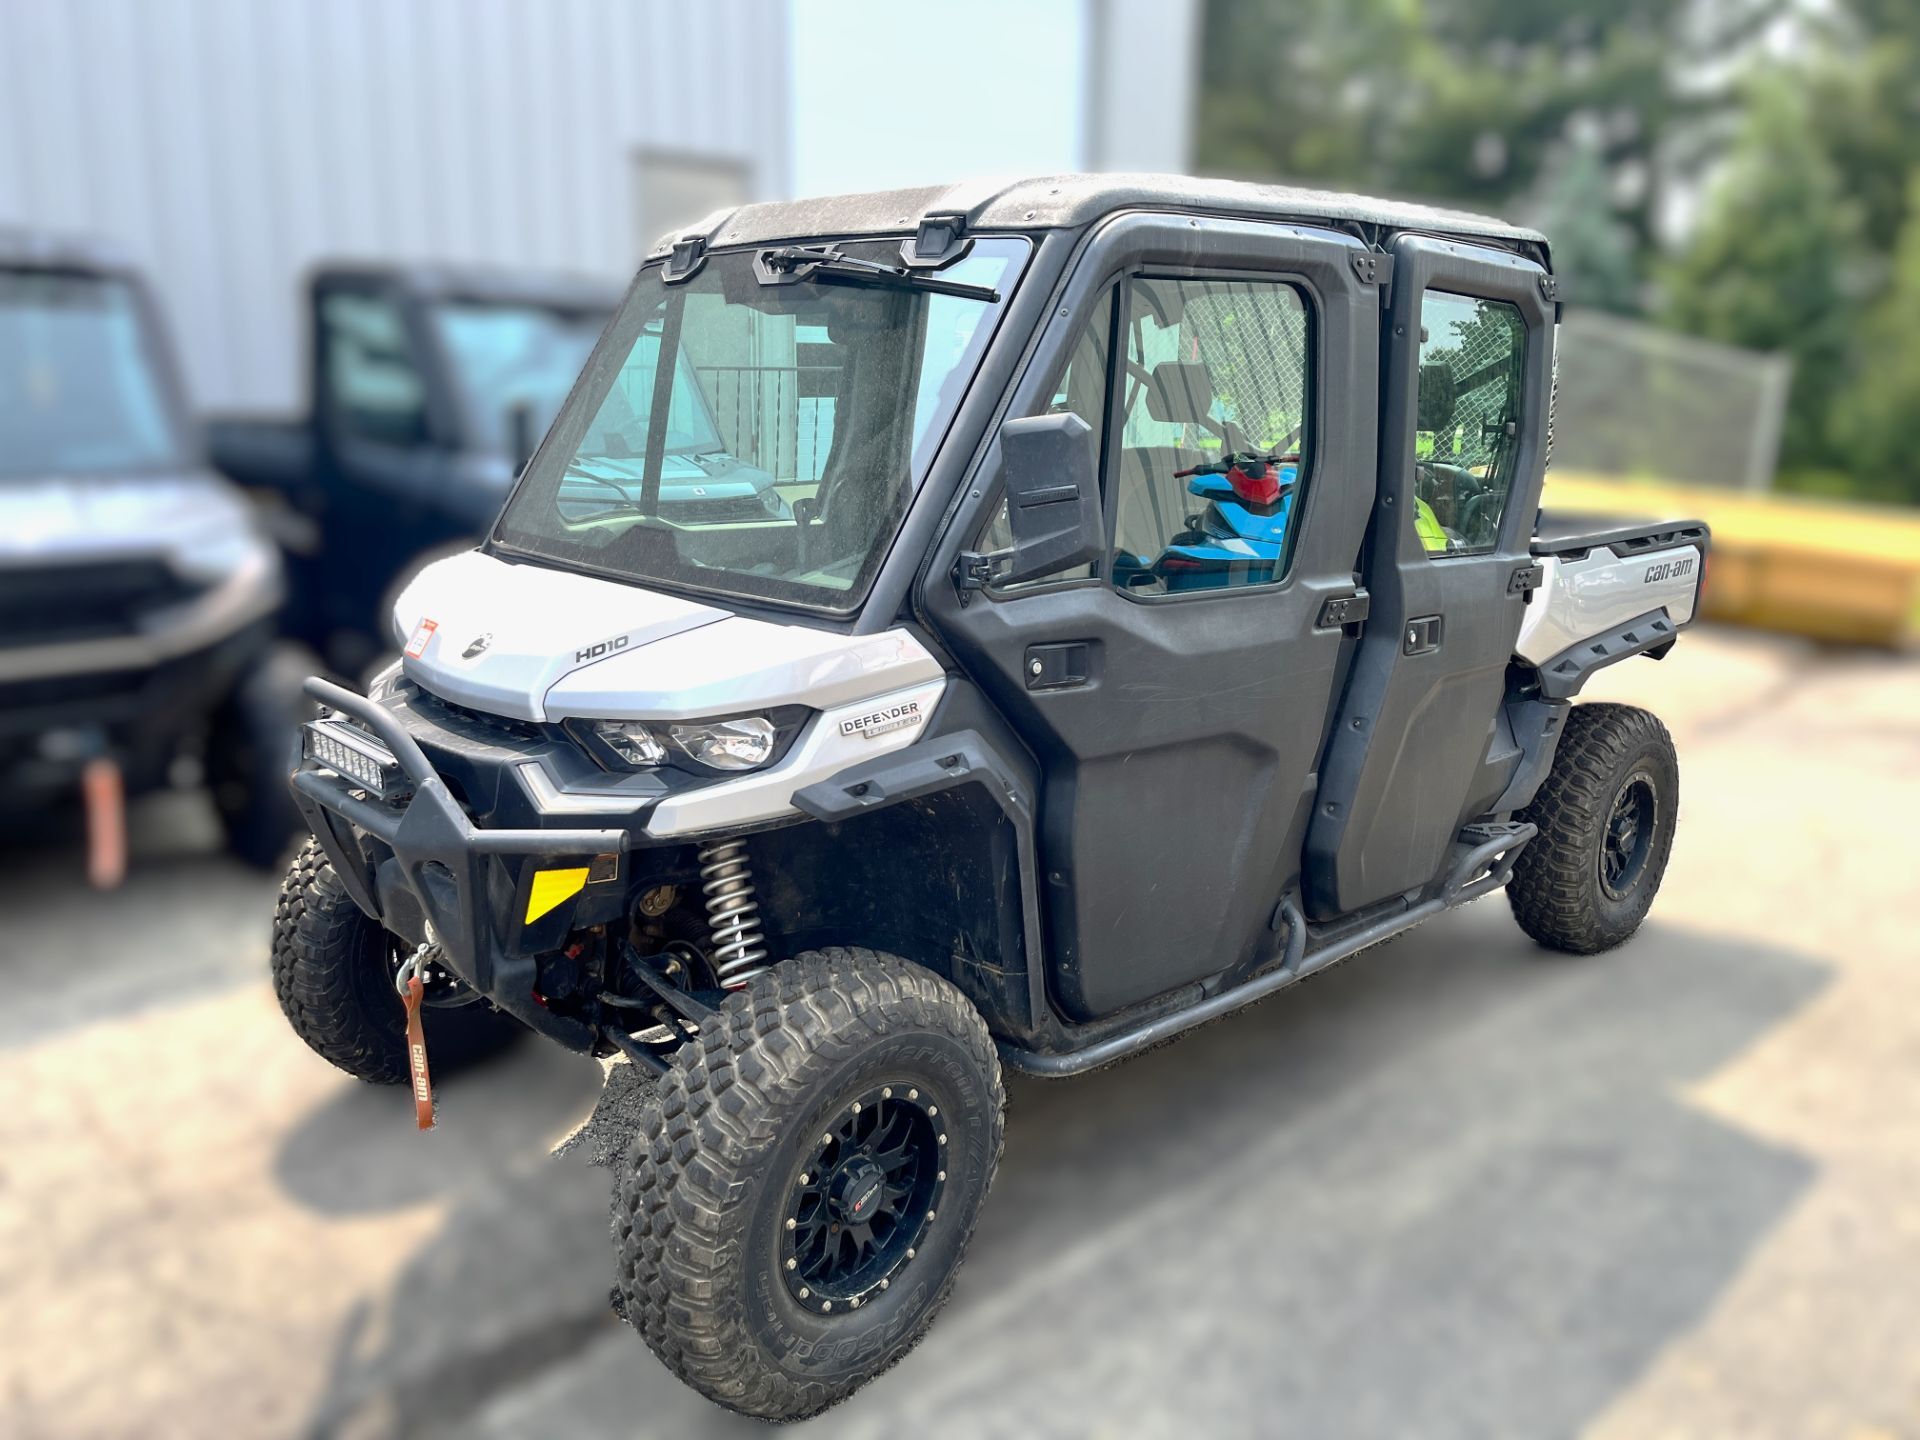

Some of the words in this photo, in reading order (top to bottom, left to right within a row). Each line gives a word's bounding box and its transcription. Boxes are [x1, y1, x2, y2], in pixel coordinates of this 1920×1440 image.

[1644, 558, 1692, 583] can-am
[575, 635, 628, 663] HD10
[844, 702, 918, 732] DEFENDER
[412, 1044, 428, 1102] can-am
